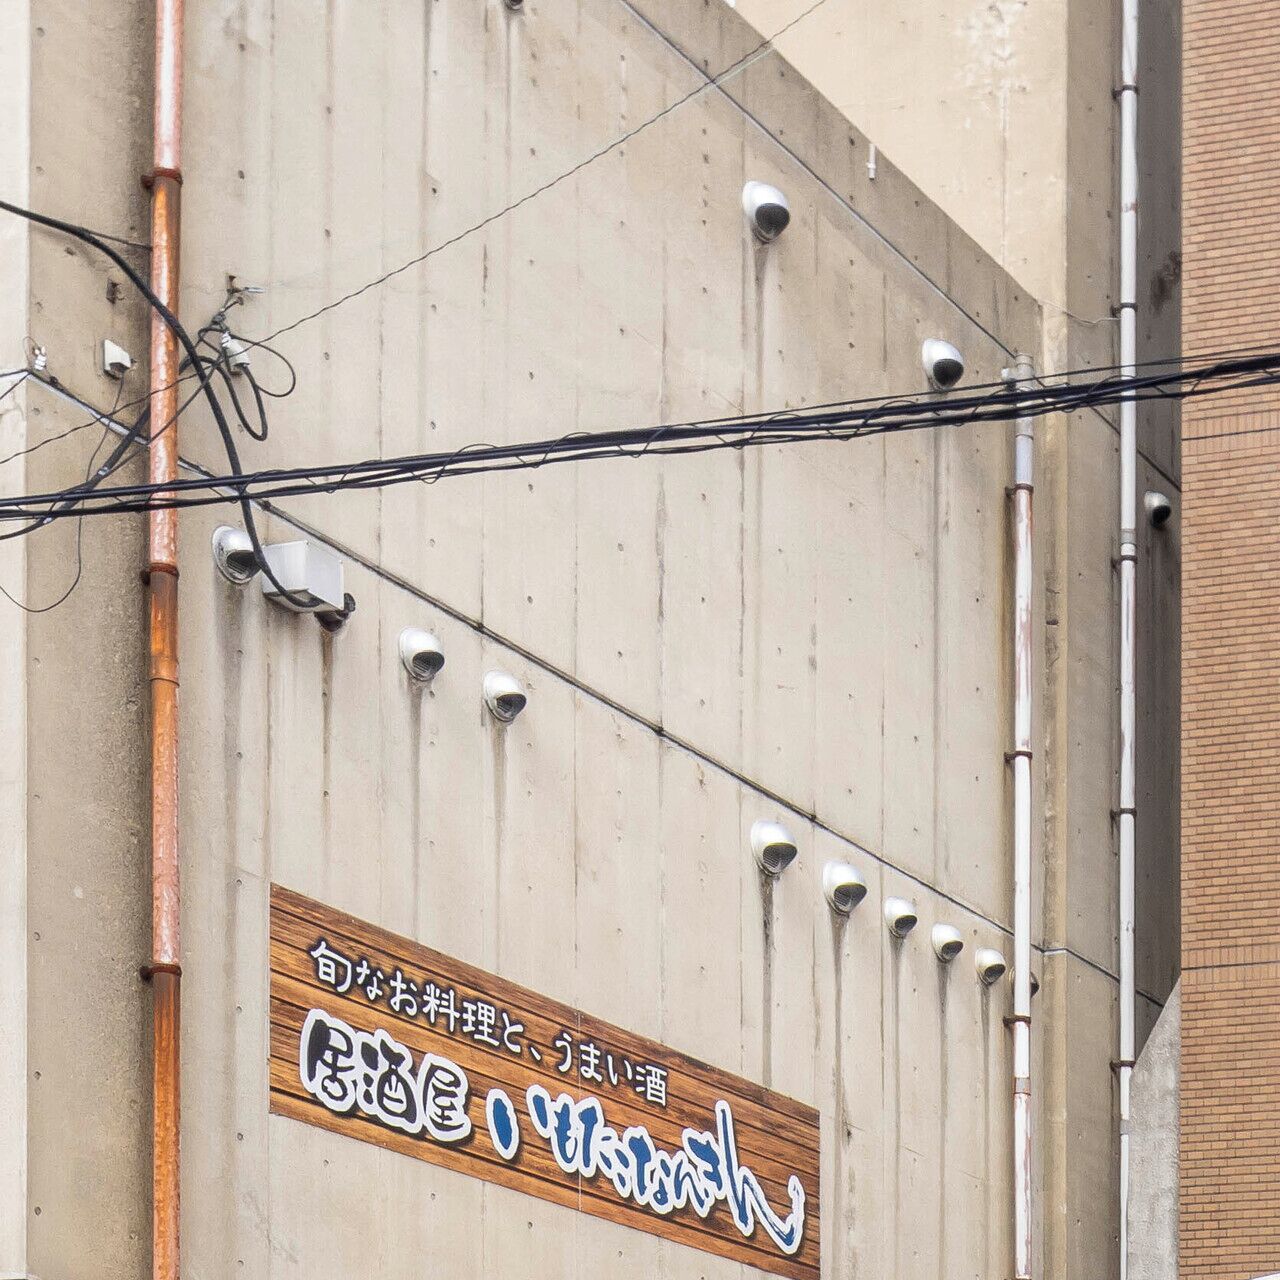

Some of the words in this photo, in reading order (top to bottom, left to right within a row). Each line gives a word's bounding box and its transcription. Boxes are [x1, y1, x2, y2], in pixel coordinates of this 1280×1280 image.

[301, 1009, 471, 1140] 居酒屋
[310, 941, 668, 1107] 旬なお料理と、うまい酒
